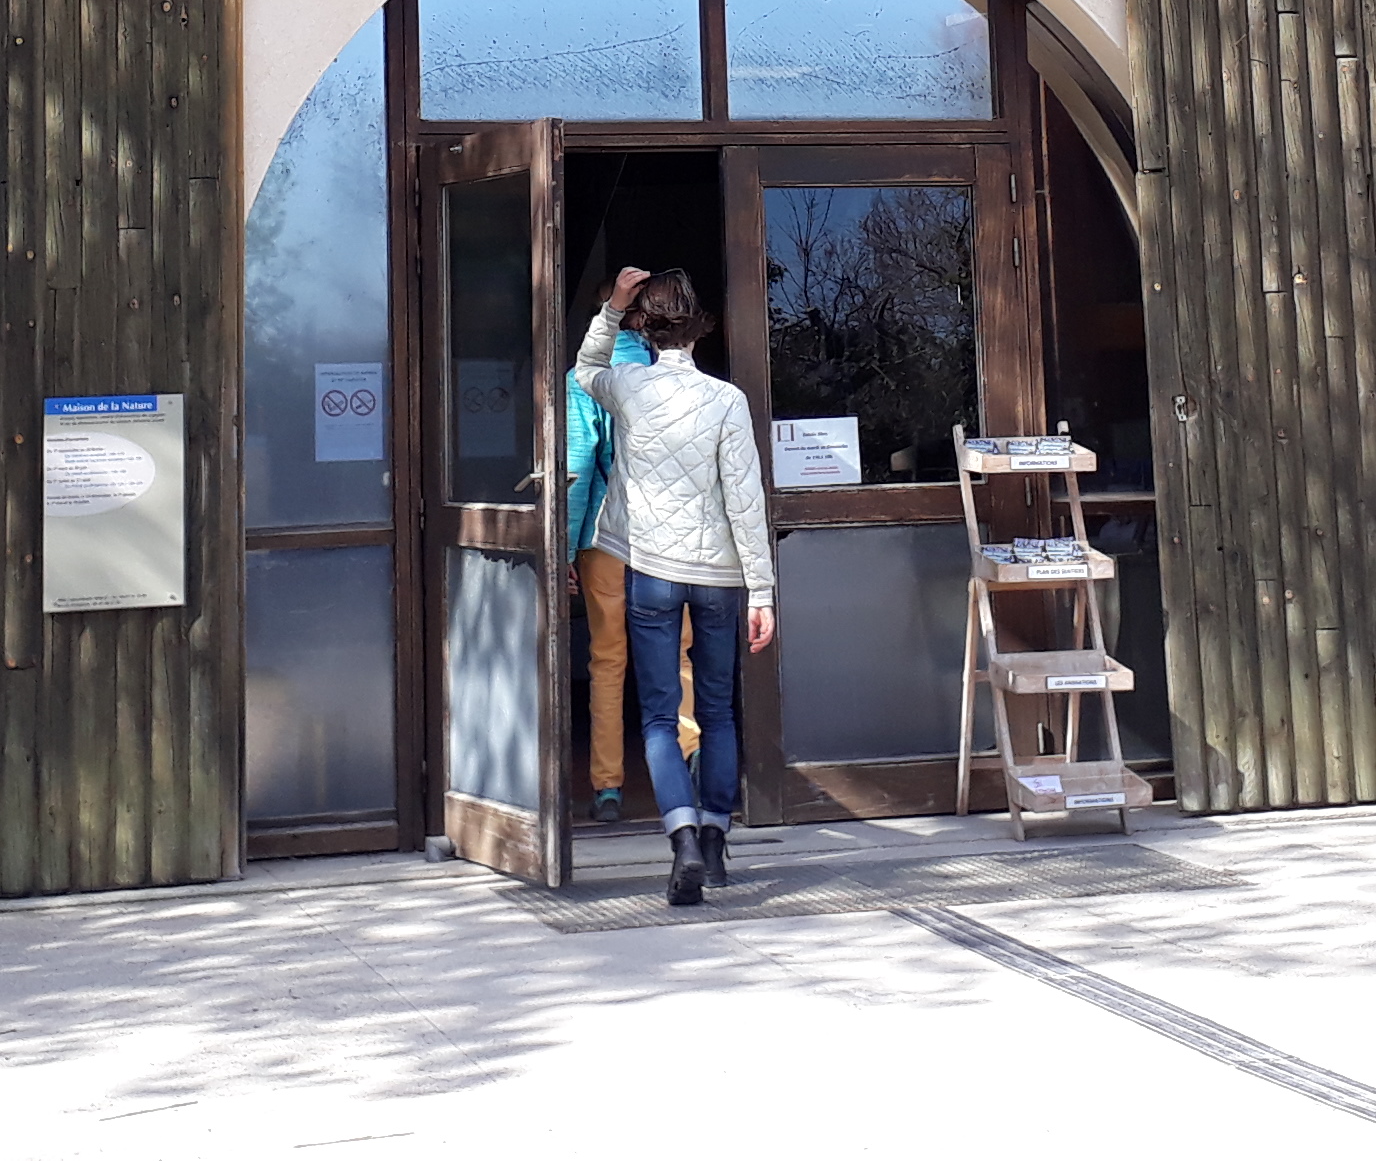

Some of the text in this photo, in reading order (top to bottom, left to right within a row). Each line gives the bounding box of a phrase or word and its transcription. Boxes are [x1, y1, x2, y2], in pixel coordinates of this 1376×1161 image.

[62, 401, 153, 413] Maison de la Nature
